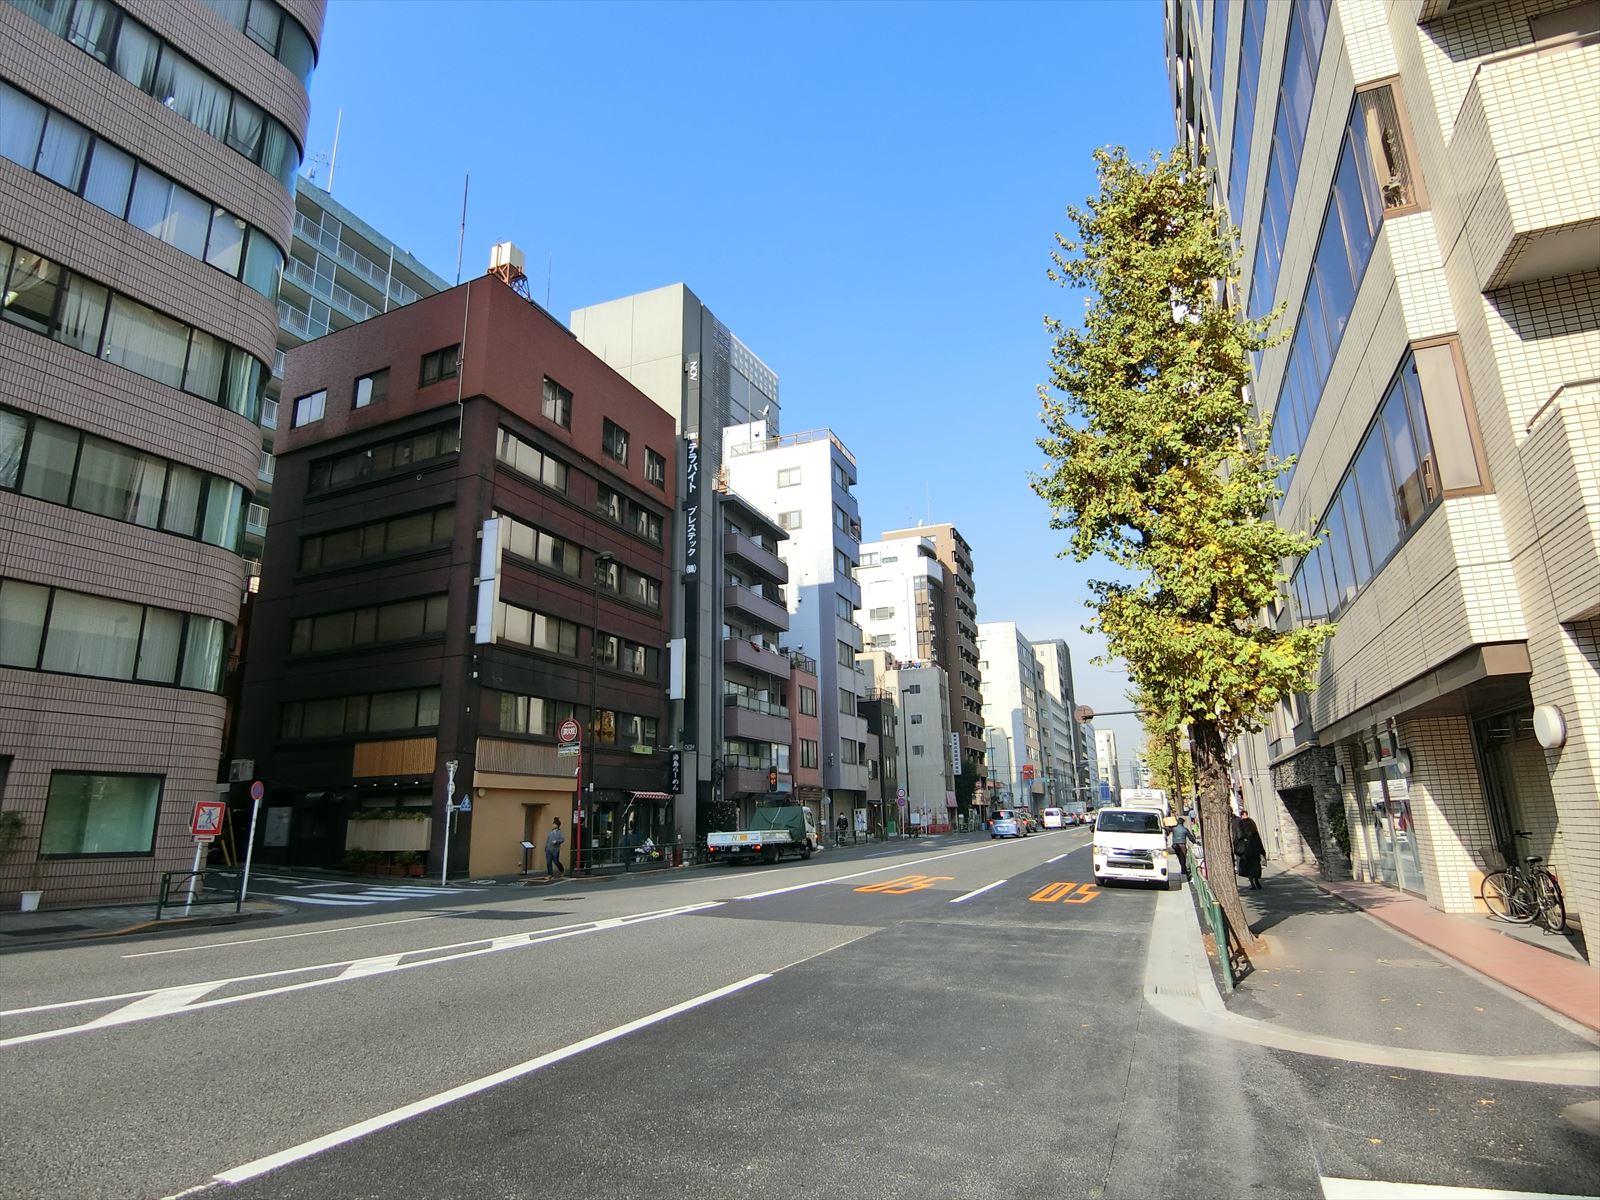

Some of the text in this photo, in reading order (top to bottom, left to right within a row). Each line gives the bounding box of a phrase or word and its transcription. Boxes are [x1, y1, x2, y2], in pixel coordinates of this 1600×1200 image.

[687, 505, 698, 557] プレステック
